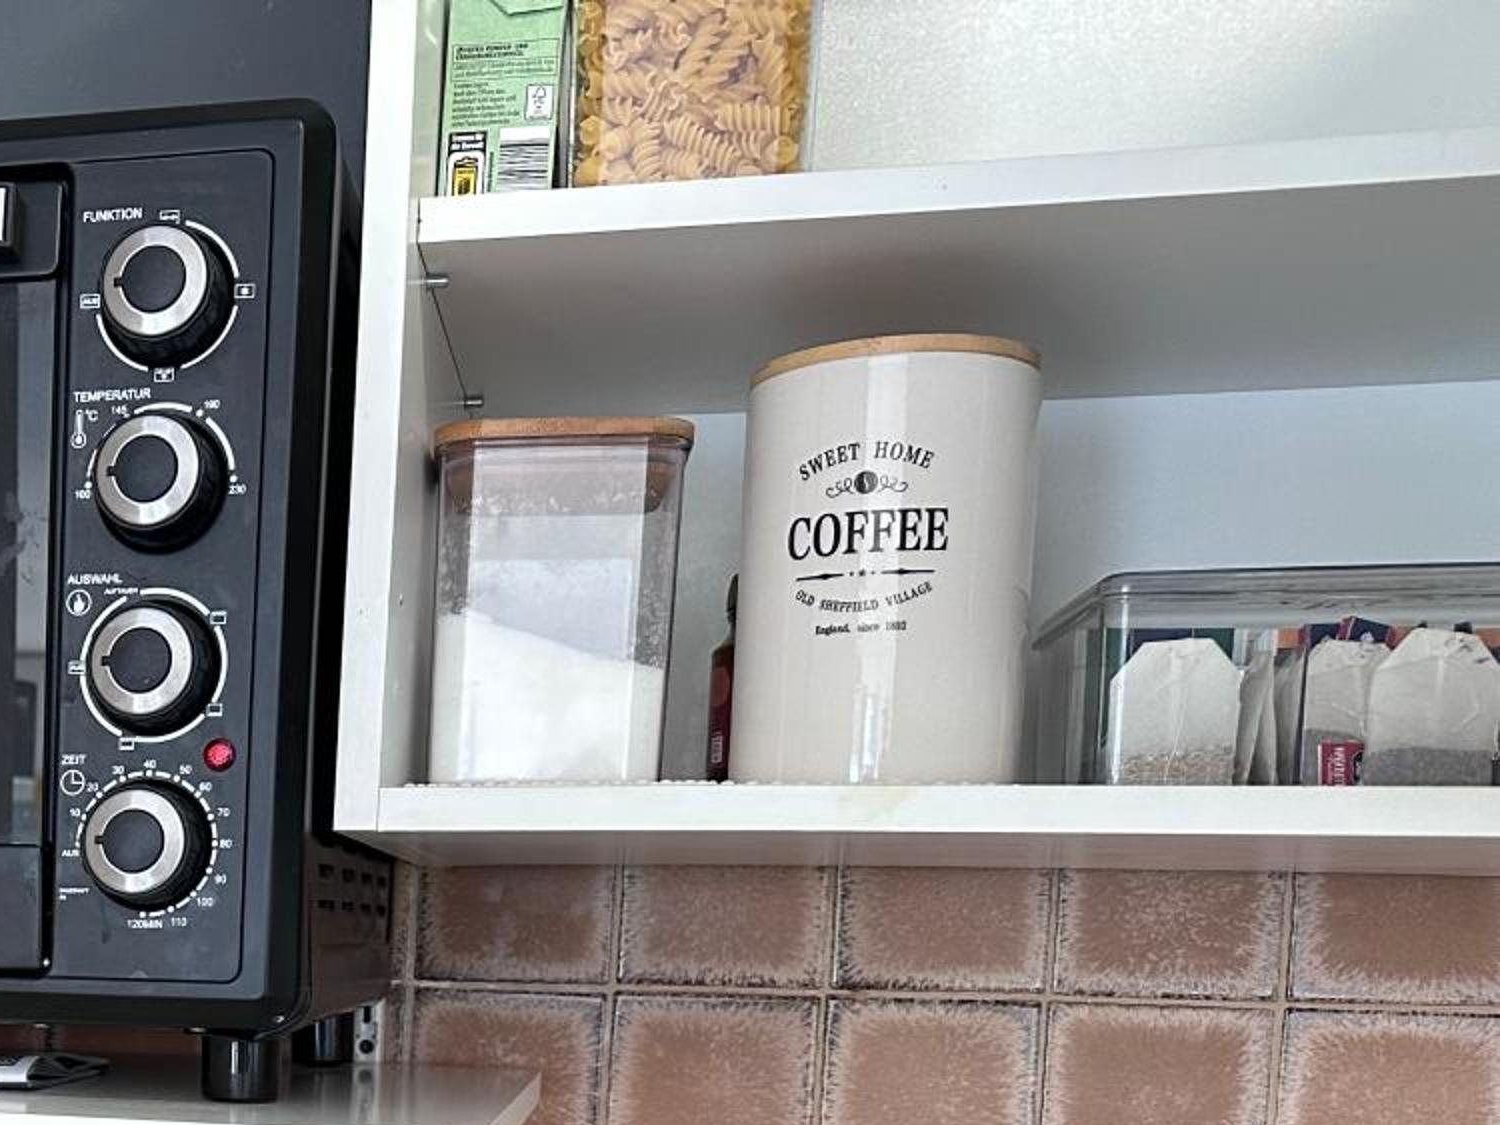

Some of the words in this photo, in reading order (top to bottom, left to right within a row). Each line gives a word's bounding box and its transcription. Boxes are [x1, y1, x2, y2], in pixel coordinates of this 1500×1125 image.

[83, 208, 142, 223] FUNKTION
[74, 389, 151, 403] TEMPERATUR
[799, 442, 860, 481] SWEET
[874, 441, 935, 469] HOME
[787, 508, 949, 561] COFFEE
[68, 573, 123, 585] AUSWAHL
[795, 589, 815, 607] OLD
[819, 600, 879, 613] SHEFFIELD
[885, 581, 933, 607] VILLAGE
[61, 754, 86, 766] ZEIT
[143, 760, 157, 769] 40
[112, 765, 125, 775] 30
[179, 764, 192, 775] 50
[86, 782, 99, 793] 20
[199, 782, 212, 792] 60
[69, 808, 81, 818] 10
[217, 808, 231, 817] 70
[220, 839, 233, 849] 80
